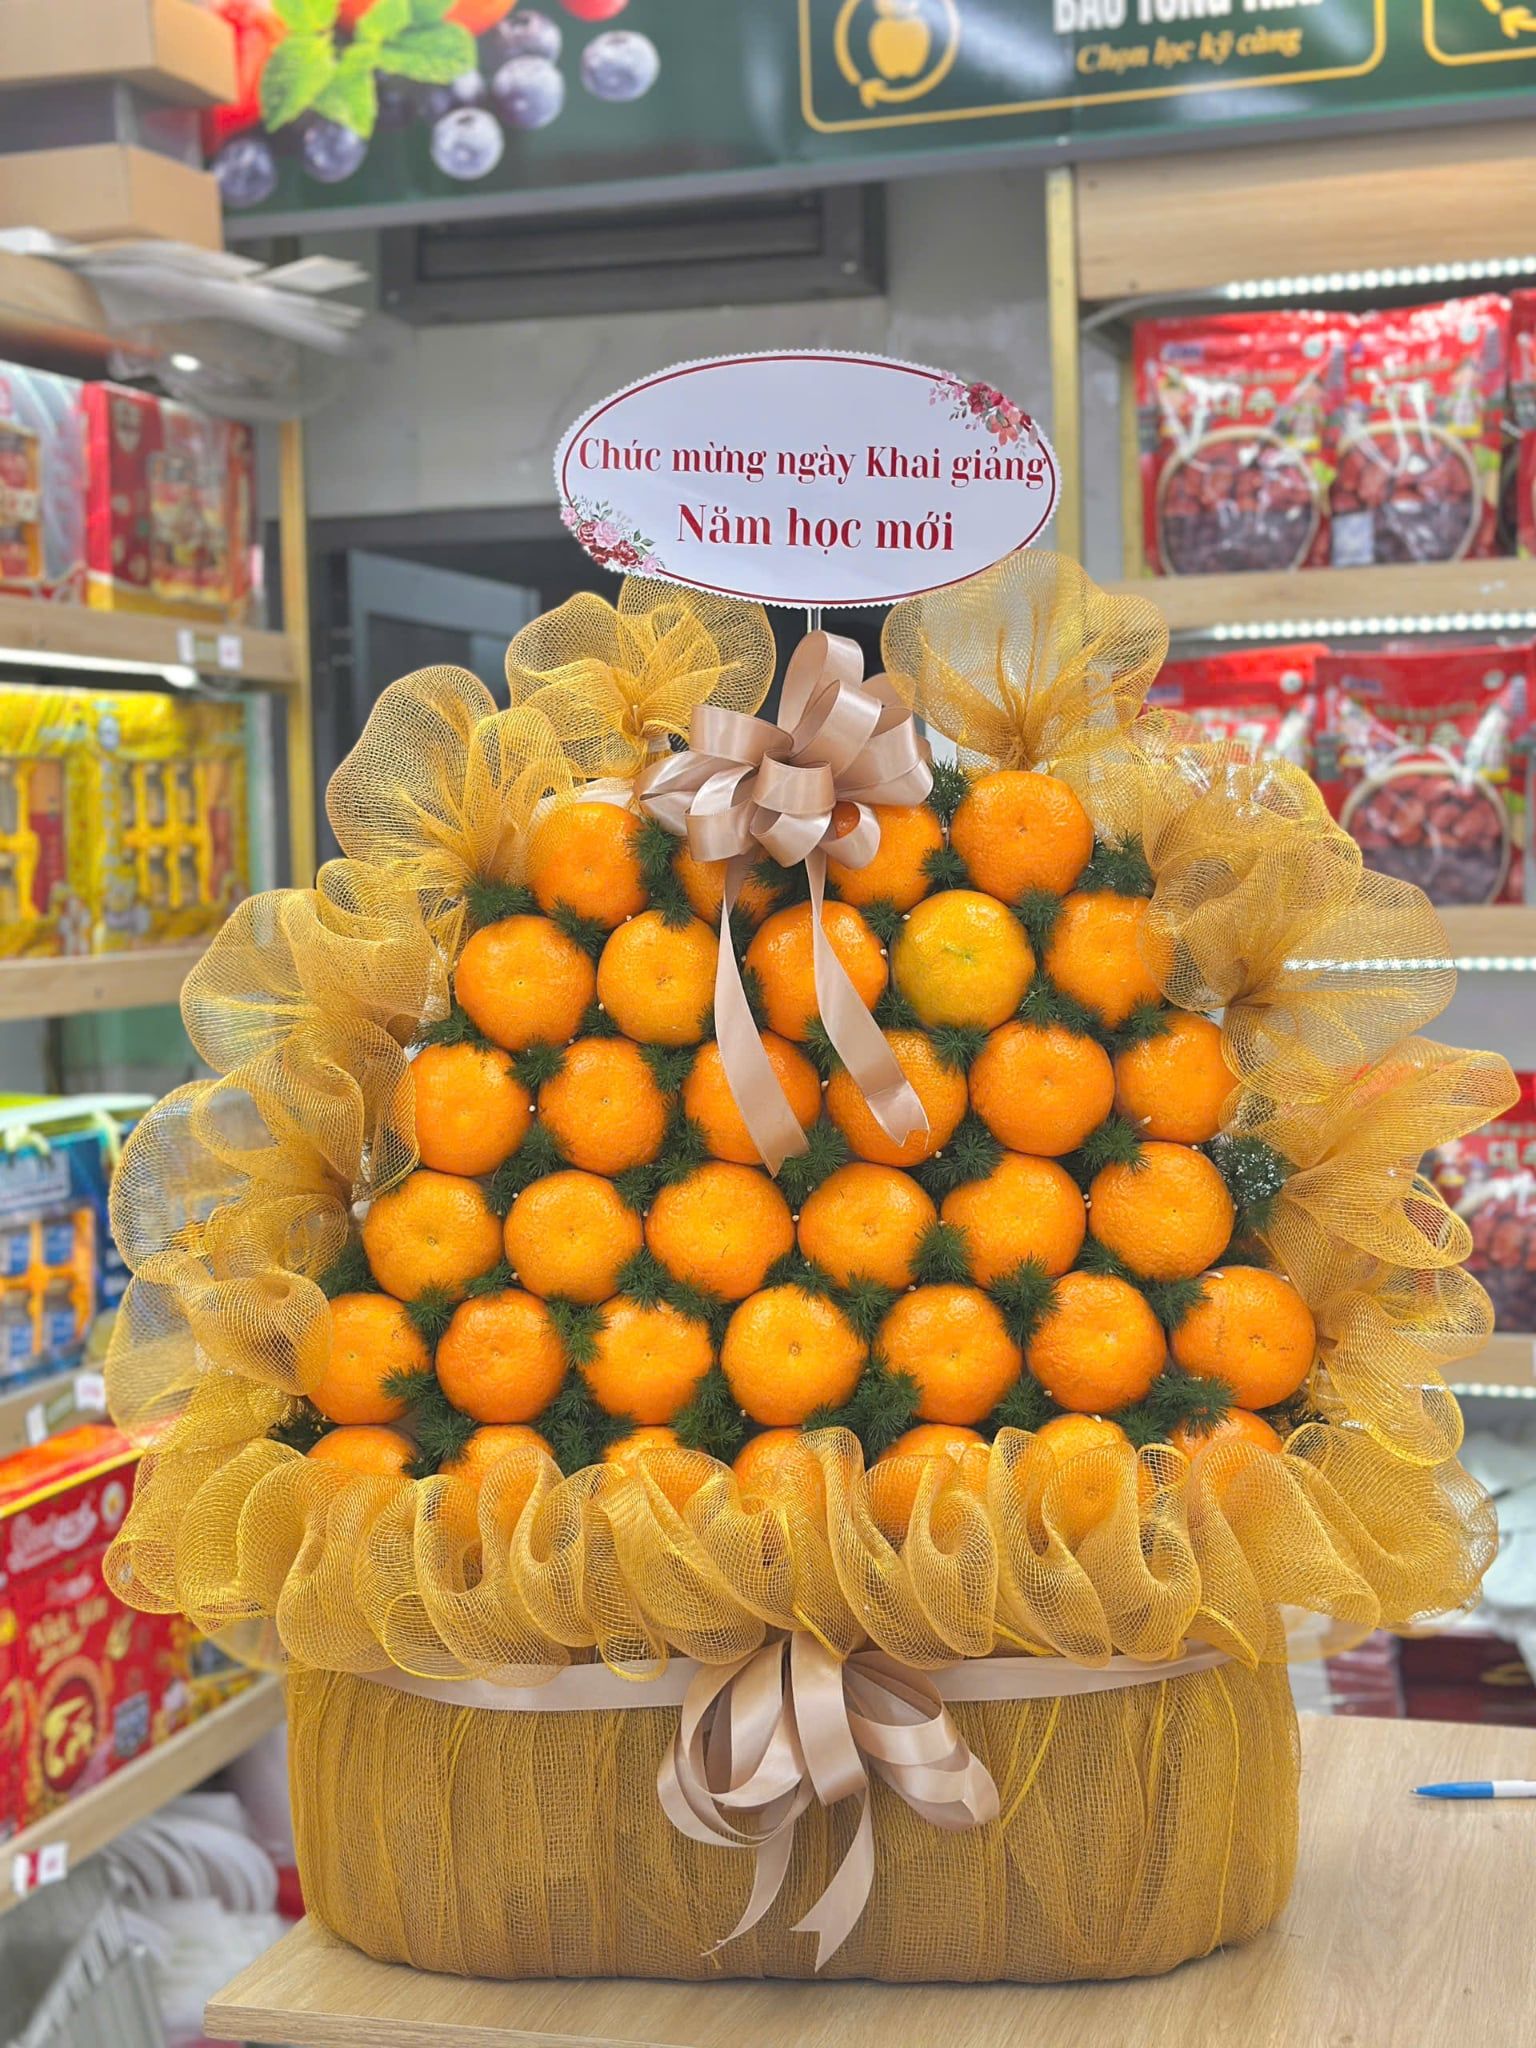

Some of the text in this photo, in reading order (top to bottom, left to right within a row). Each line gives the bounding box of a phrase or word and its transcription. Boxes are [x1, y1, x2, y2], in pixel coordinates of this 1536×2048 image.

[1077, 42, 1149, 75] Chọn
[1153, 36, 1196, 69] lọc
[1199, 30, 1234, 64] kỹ
[579, 437, 1047, 490] Chúc mừng ngày Khai giảng
[677, 503, 954, 555] Năm học mới
